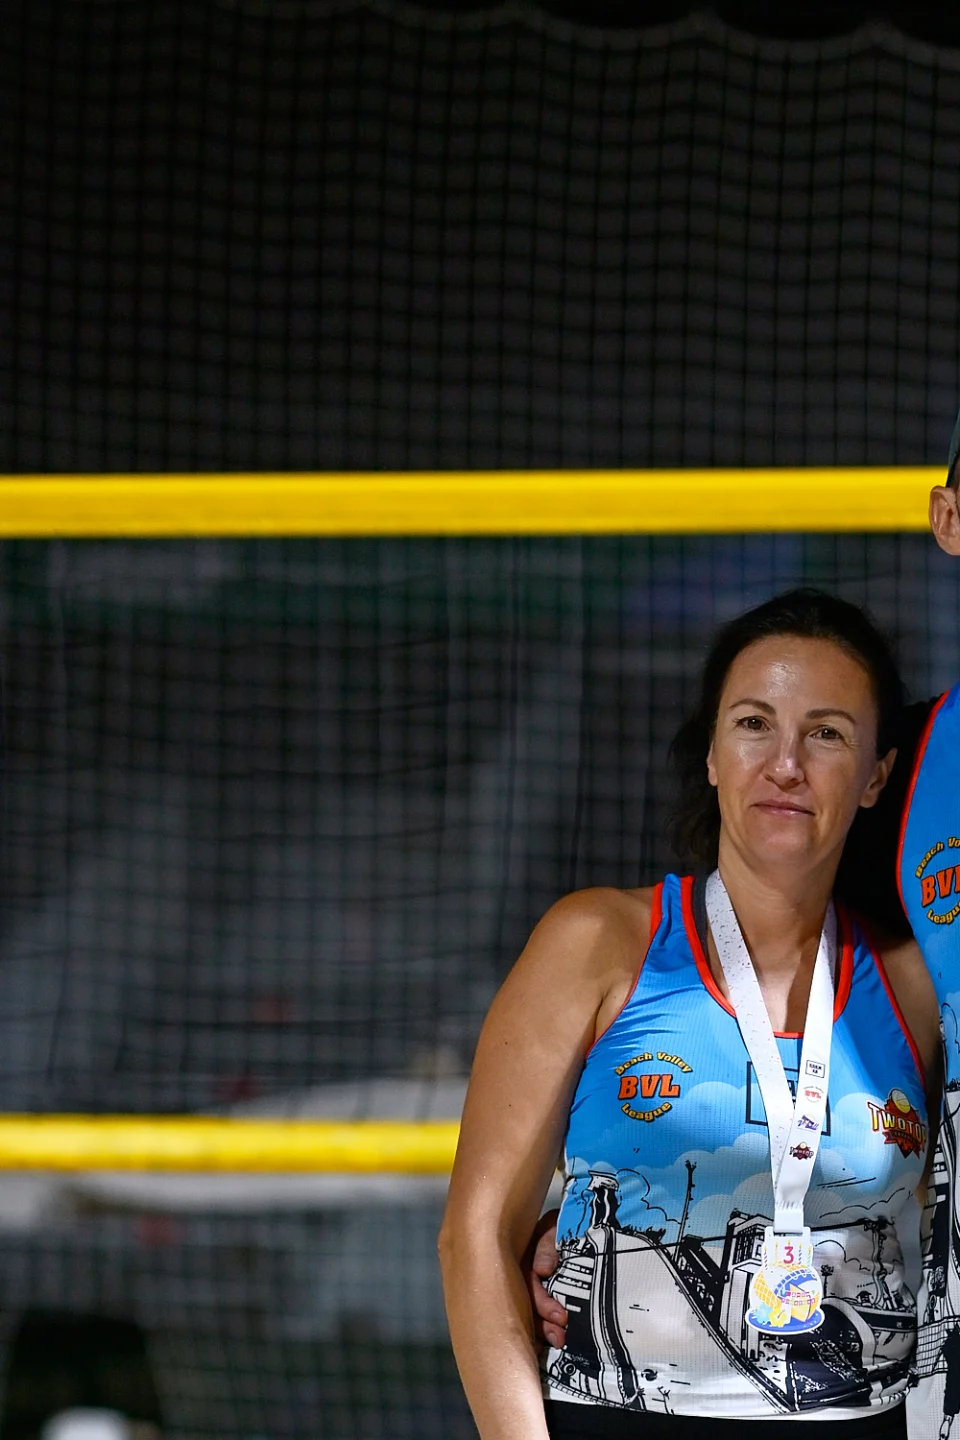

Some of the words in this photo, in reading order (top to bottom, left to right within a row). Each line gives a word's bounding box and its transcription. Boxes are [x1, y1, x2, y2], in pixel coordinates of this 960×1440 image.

[915, 842, 945, 878] Beach
[614, 1052, 653, 1076] Beach
[656, 1051, 693, 1074] Volley
[618, 1074, 680, 1100] BVL
[621, 1102, 673, 1123] League
[783, 1245, 795, 1264] 3
